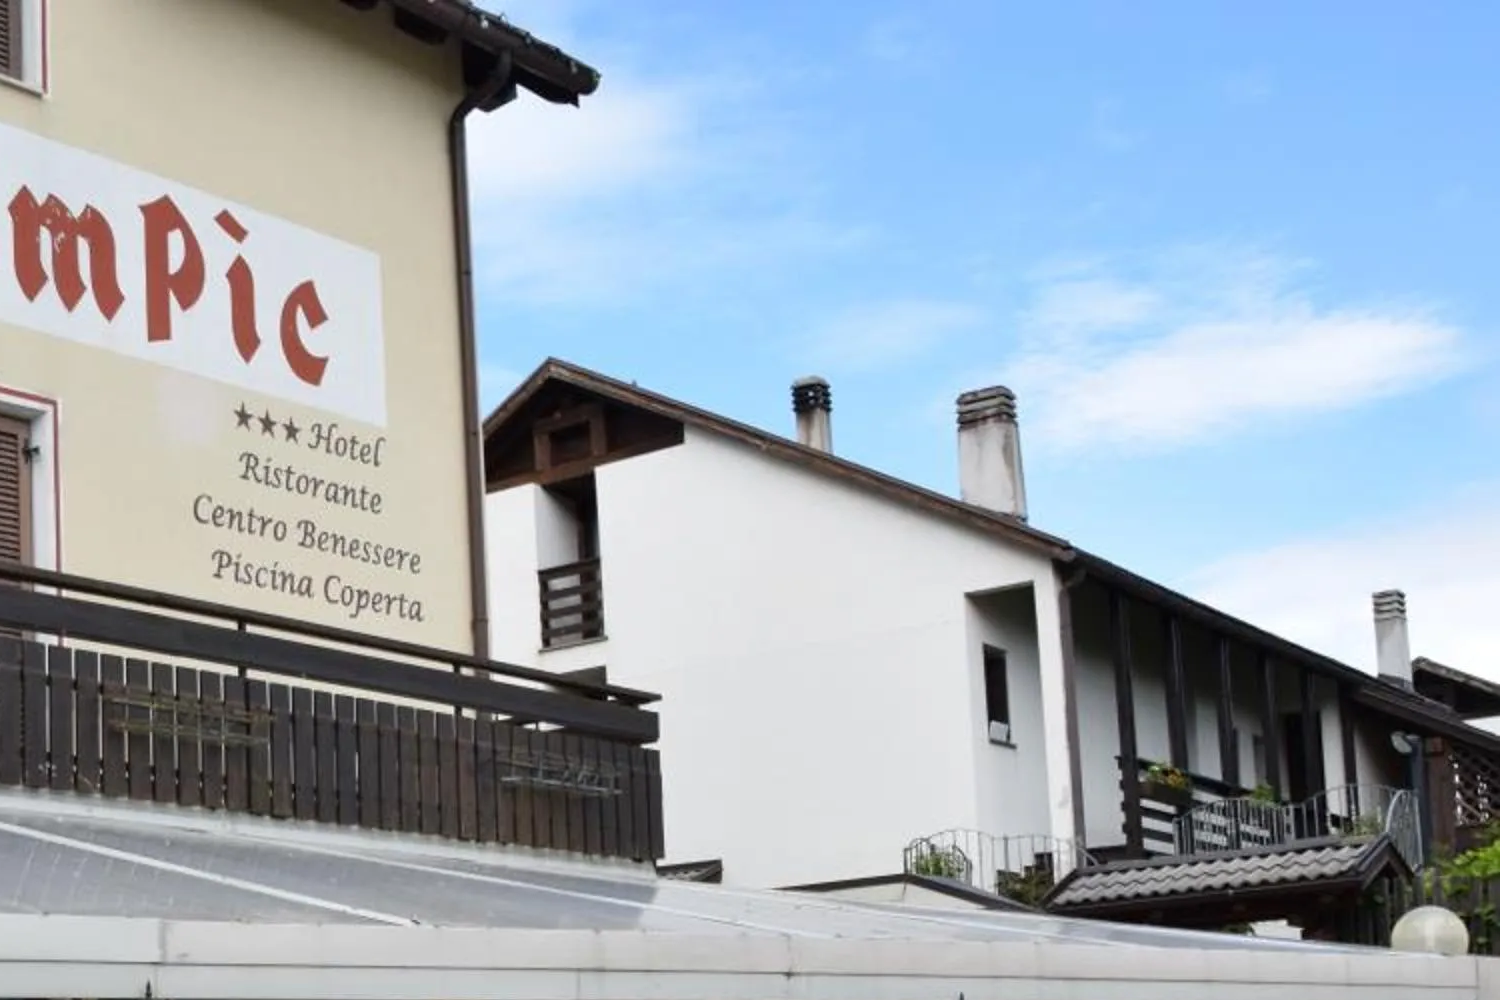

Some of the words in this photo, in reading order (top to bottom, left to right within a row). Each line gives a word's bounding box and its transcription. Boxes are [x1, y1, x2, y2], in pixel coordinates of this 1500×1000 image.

[308, 423, 386, 467] Hotel
[238, 451, 382, 514] Ristorante
[193, 494, 287, 542] Centro
[297, 519, 421, 574] Benessere
[212, 549, 314, 599] Piscina
[324, 575, 424, 622] Coperta
